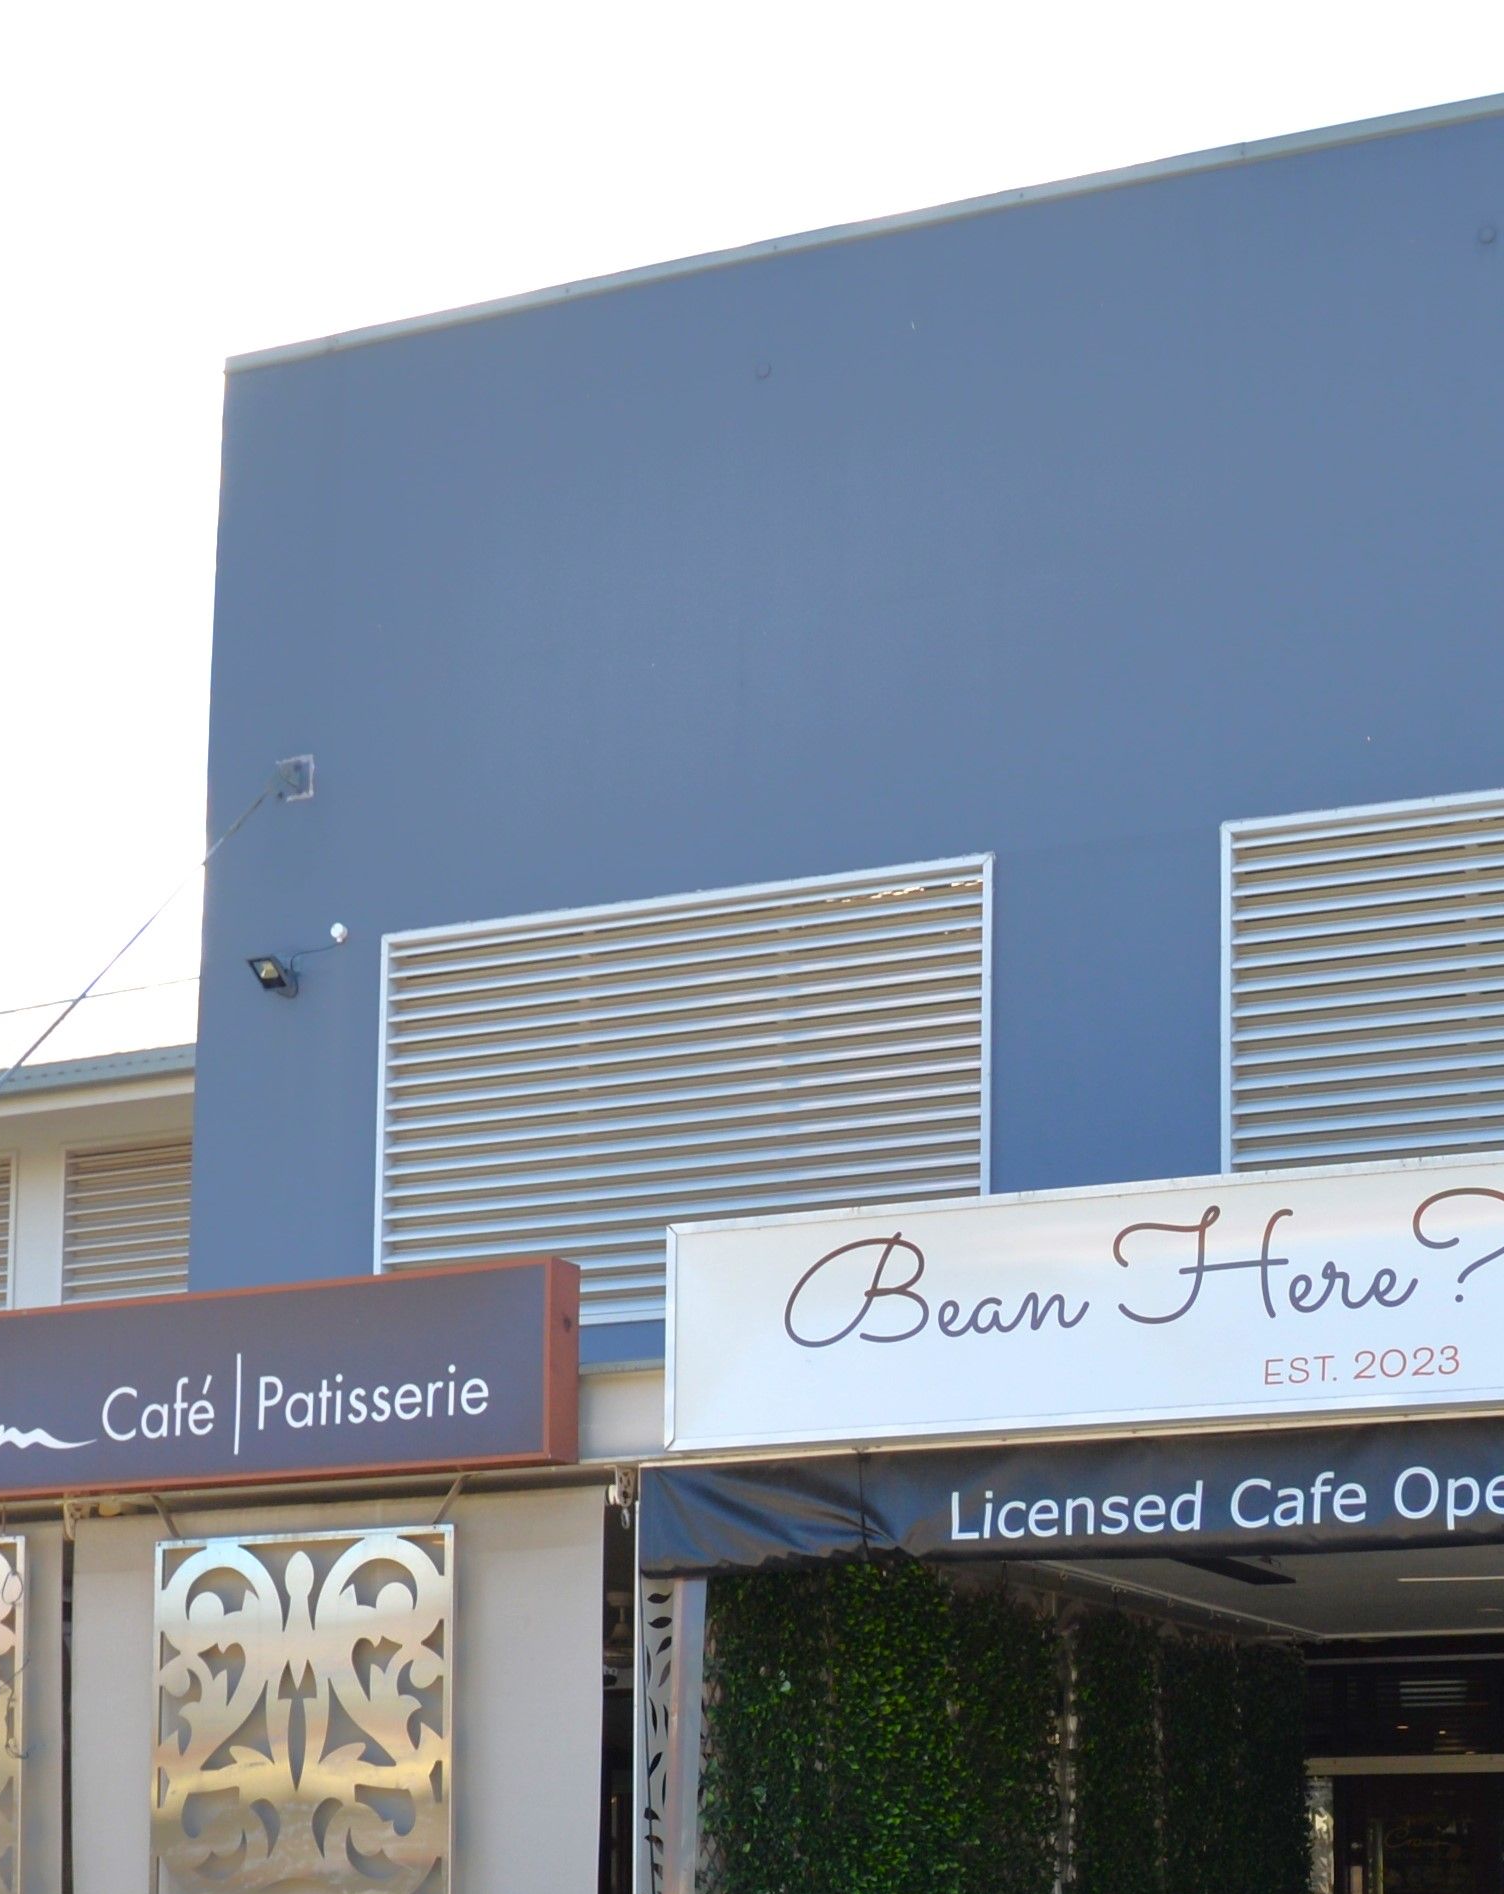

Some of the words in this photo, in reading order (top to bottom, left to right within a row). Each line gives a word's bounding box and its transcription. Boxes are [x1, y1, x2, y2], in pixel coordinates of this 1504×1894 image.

[784, 1232, 1089, 1348] Bean
[1263, 1354, 1338, 1386] EST.
[1352, 1345, 1461, 1380] 2023
[102, 1375, 215, 1443] Café
[258, 1364, 490, 1431] Patisserie
[949, 1480, 1205, 1541] Licensed
[1229, 1471, 1368, 1529] Cafe
